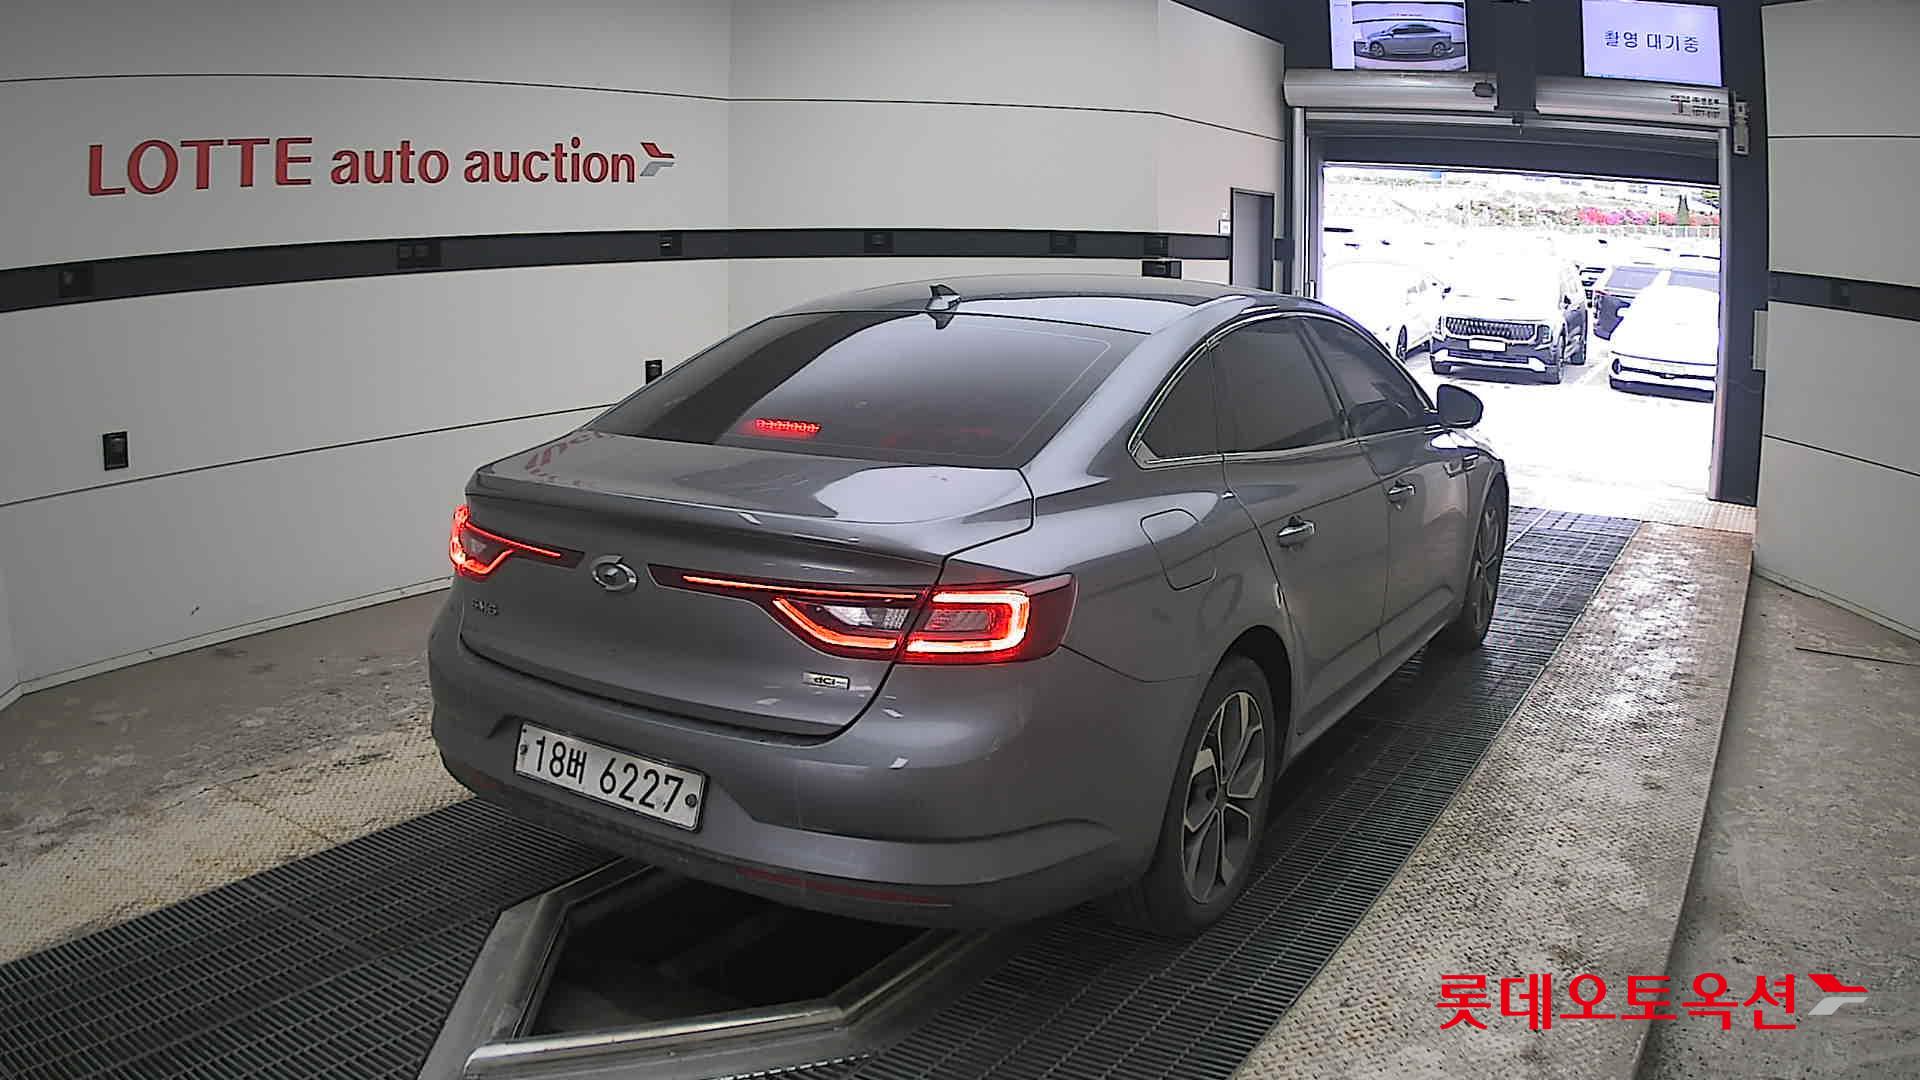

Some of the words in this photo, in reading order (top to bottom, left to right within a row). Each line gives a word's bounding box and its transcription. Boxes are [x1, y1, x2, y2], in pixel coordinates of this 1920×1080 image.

[1604, 31, 1638, 48] 촬영
[1646, 33, 1699, 53] 대기중
[88, 137, 313, 196] LOTTE
[330, 138, 449, 184] auto
[463, 137, 637, 184] auction
[536, 735, 588, 785] 18버
[600, 757, 684, 813] 6227
